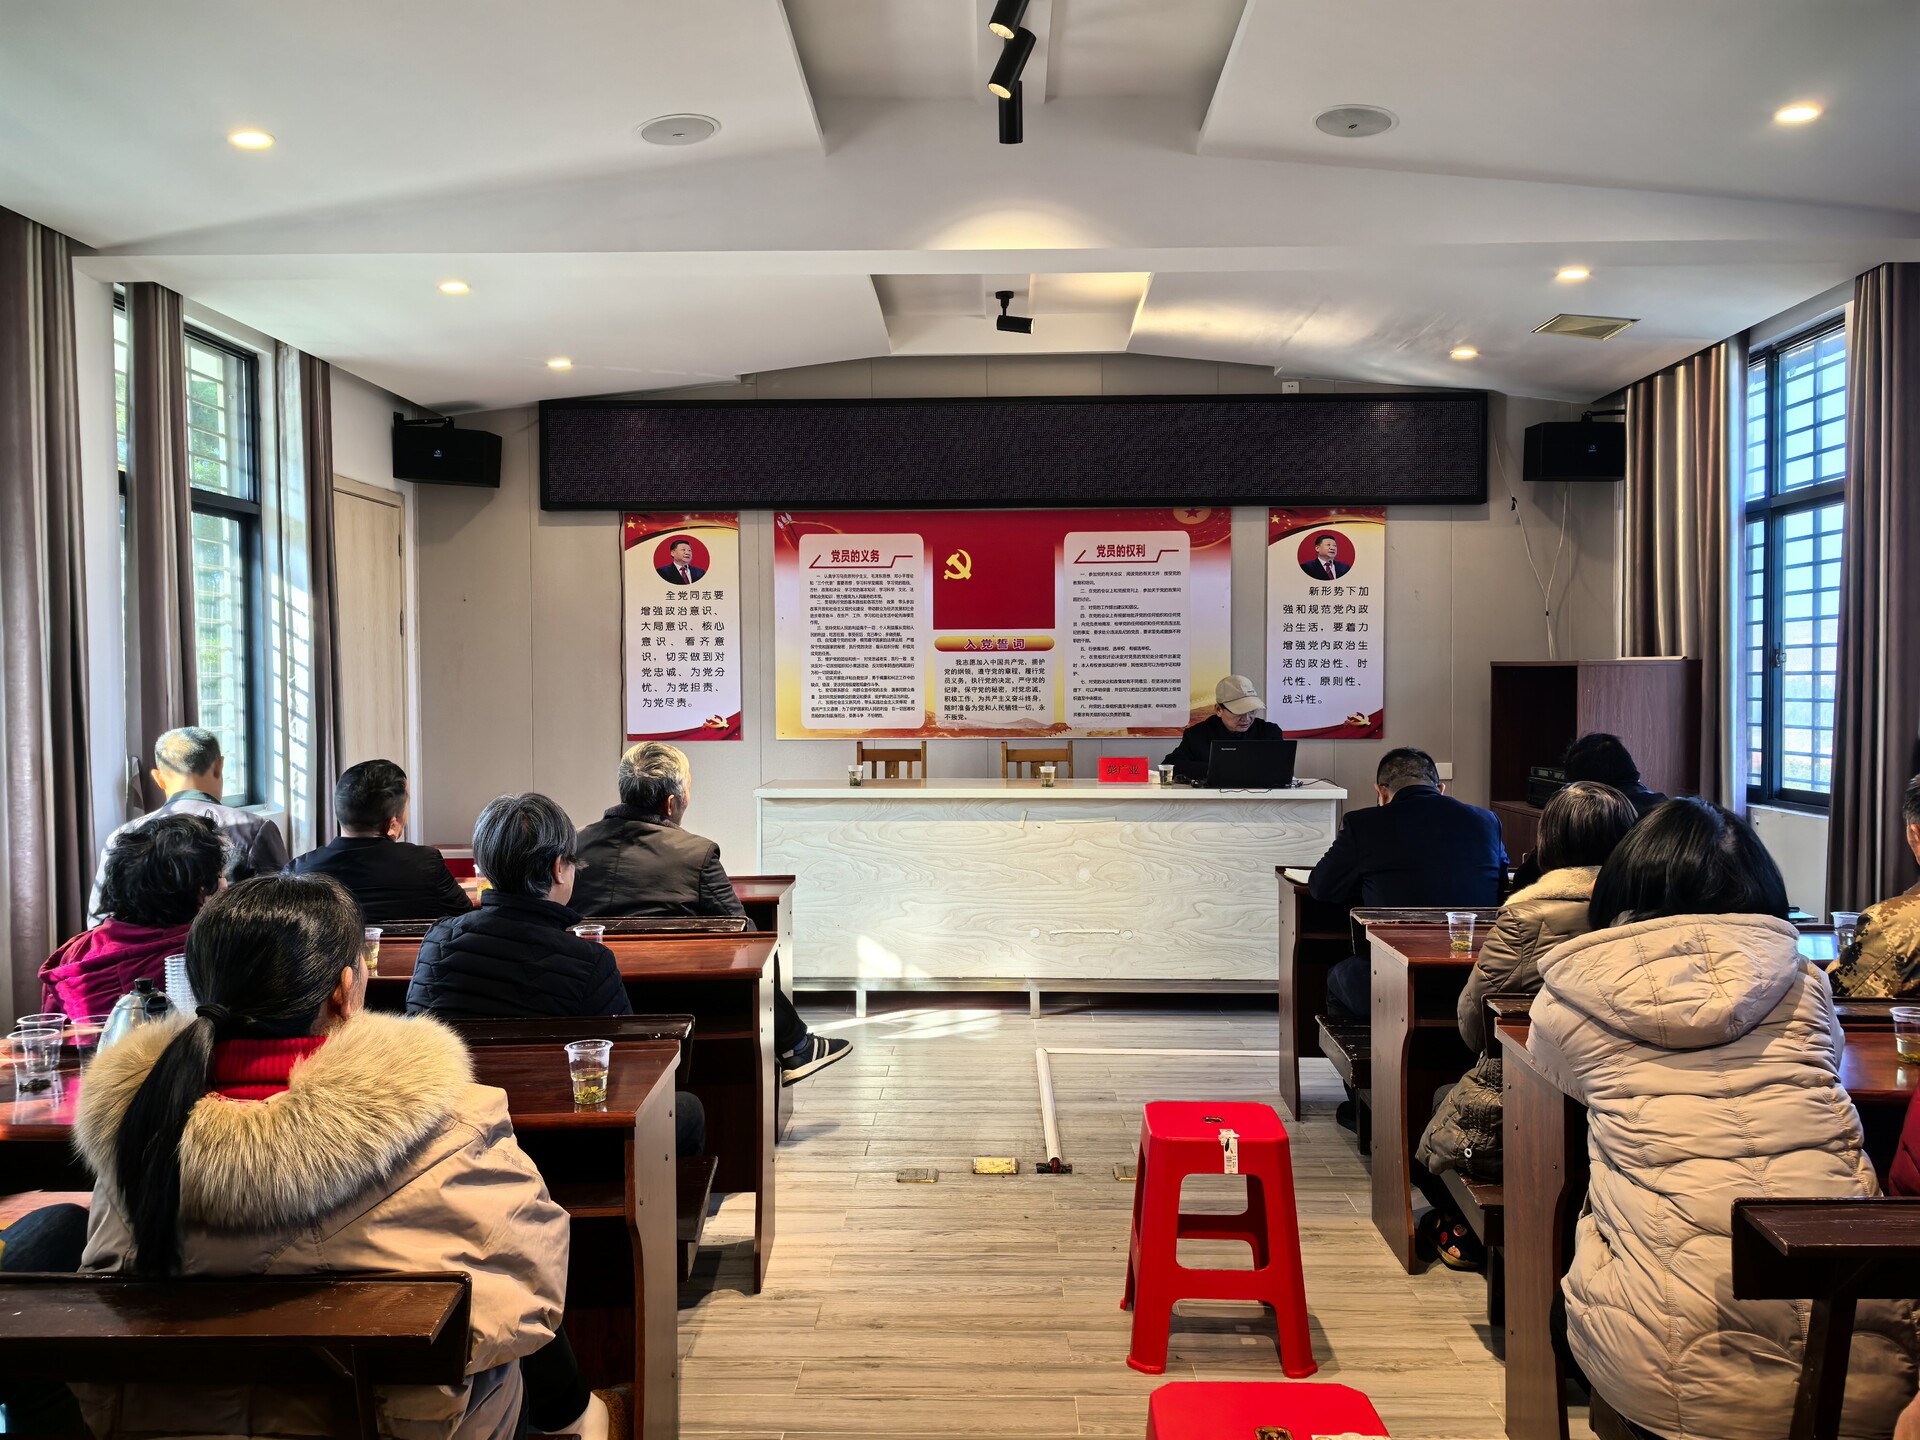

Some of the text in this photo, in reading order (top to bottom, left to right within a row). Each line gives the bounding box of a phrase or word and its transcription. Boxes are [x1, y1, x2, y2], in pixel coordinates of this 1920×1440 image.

[831, 549, 880, 563] 党员的义务
[1096, 544, 1146, 558] 党员的权利
[666, 591, 724, 601] 全党同志要
[1309, 586, 1369, 597] 新形势下加
[641, 621, 725, 631] 大局意识、核心
[641, 637, 725, 646] 意识、看齐意
[964, 638, 1025, 650] 入党誓词
[1283, 658, 1368, 668] 活的政治性、时
[642, 667, 725, 677] 党忠诚、为党分
[1282, 676, 1363, 686] 代性、原则性、
[642, 682, 721, 692] 忧、为党担责、
[642, 697, 693, 708] 为党尽责。
[1282, 694, 1324, 704] 战斗性。
[944, 713, 967, 721] 不叛党。
